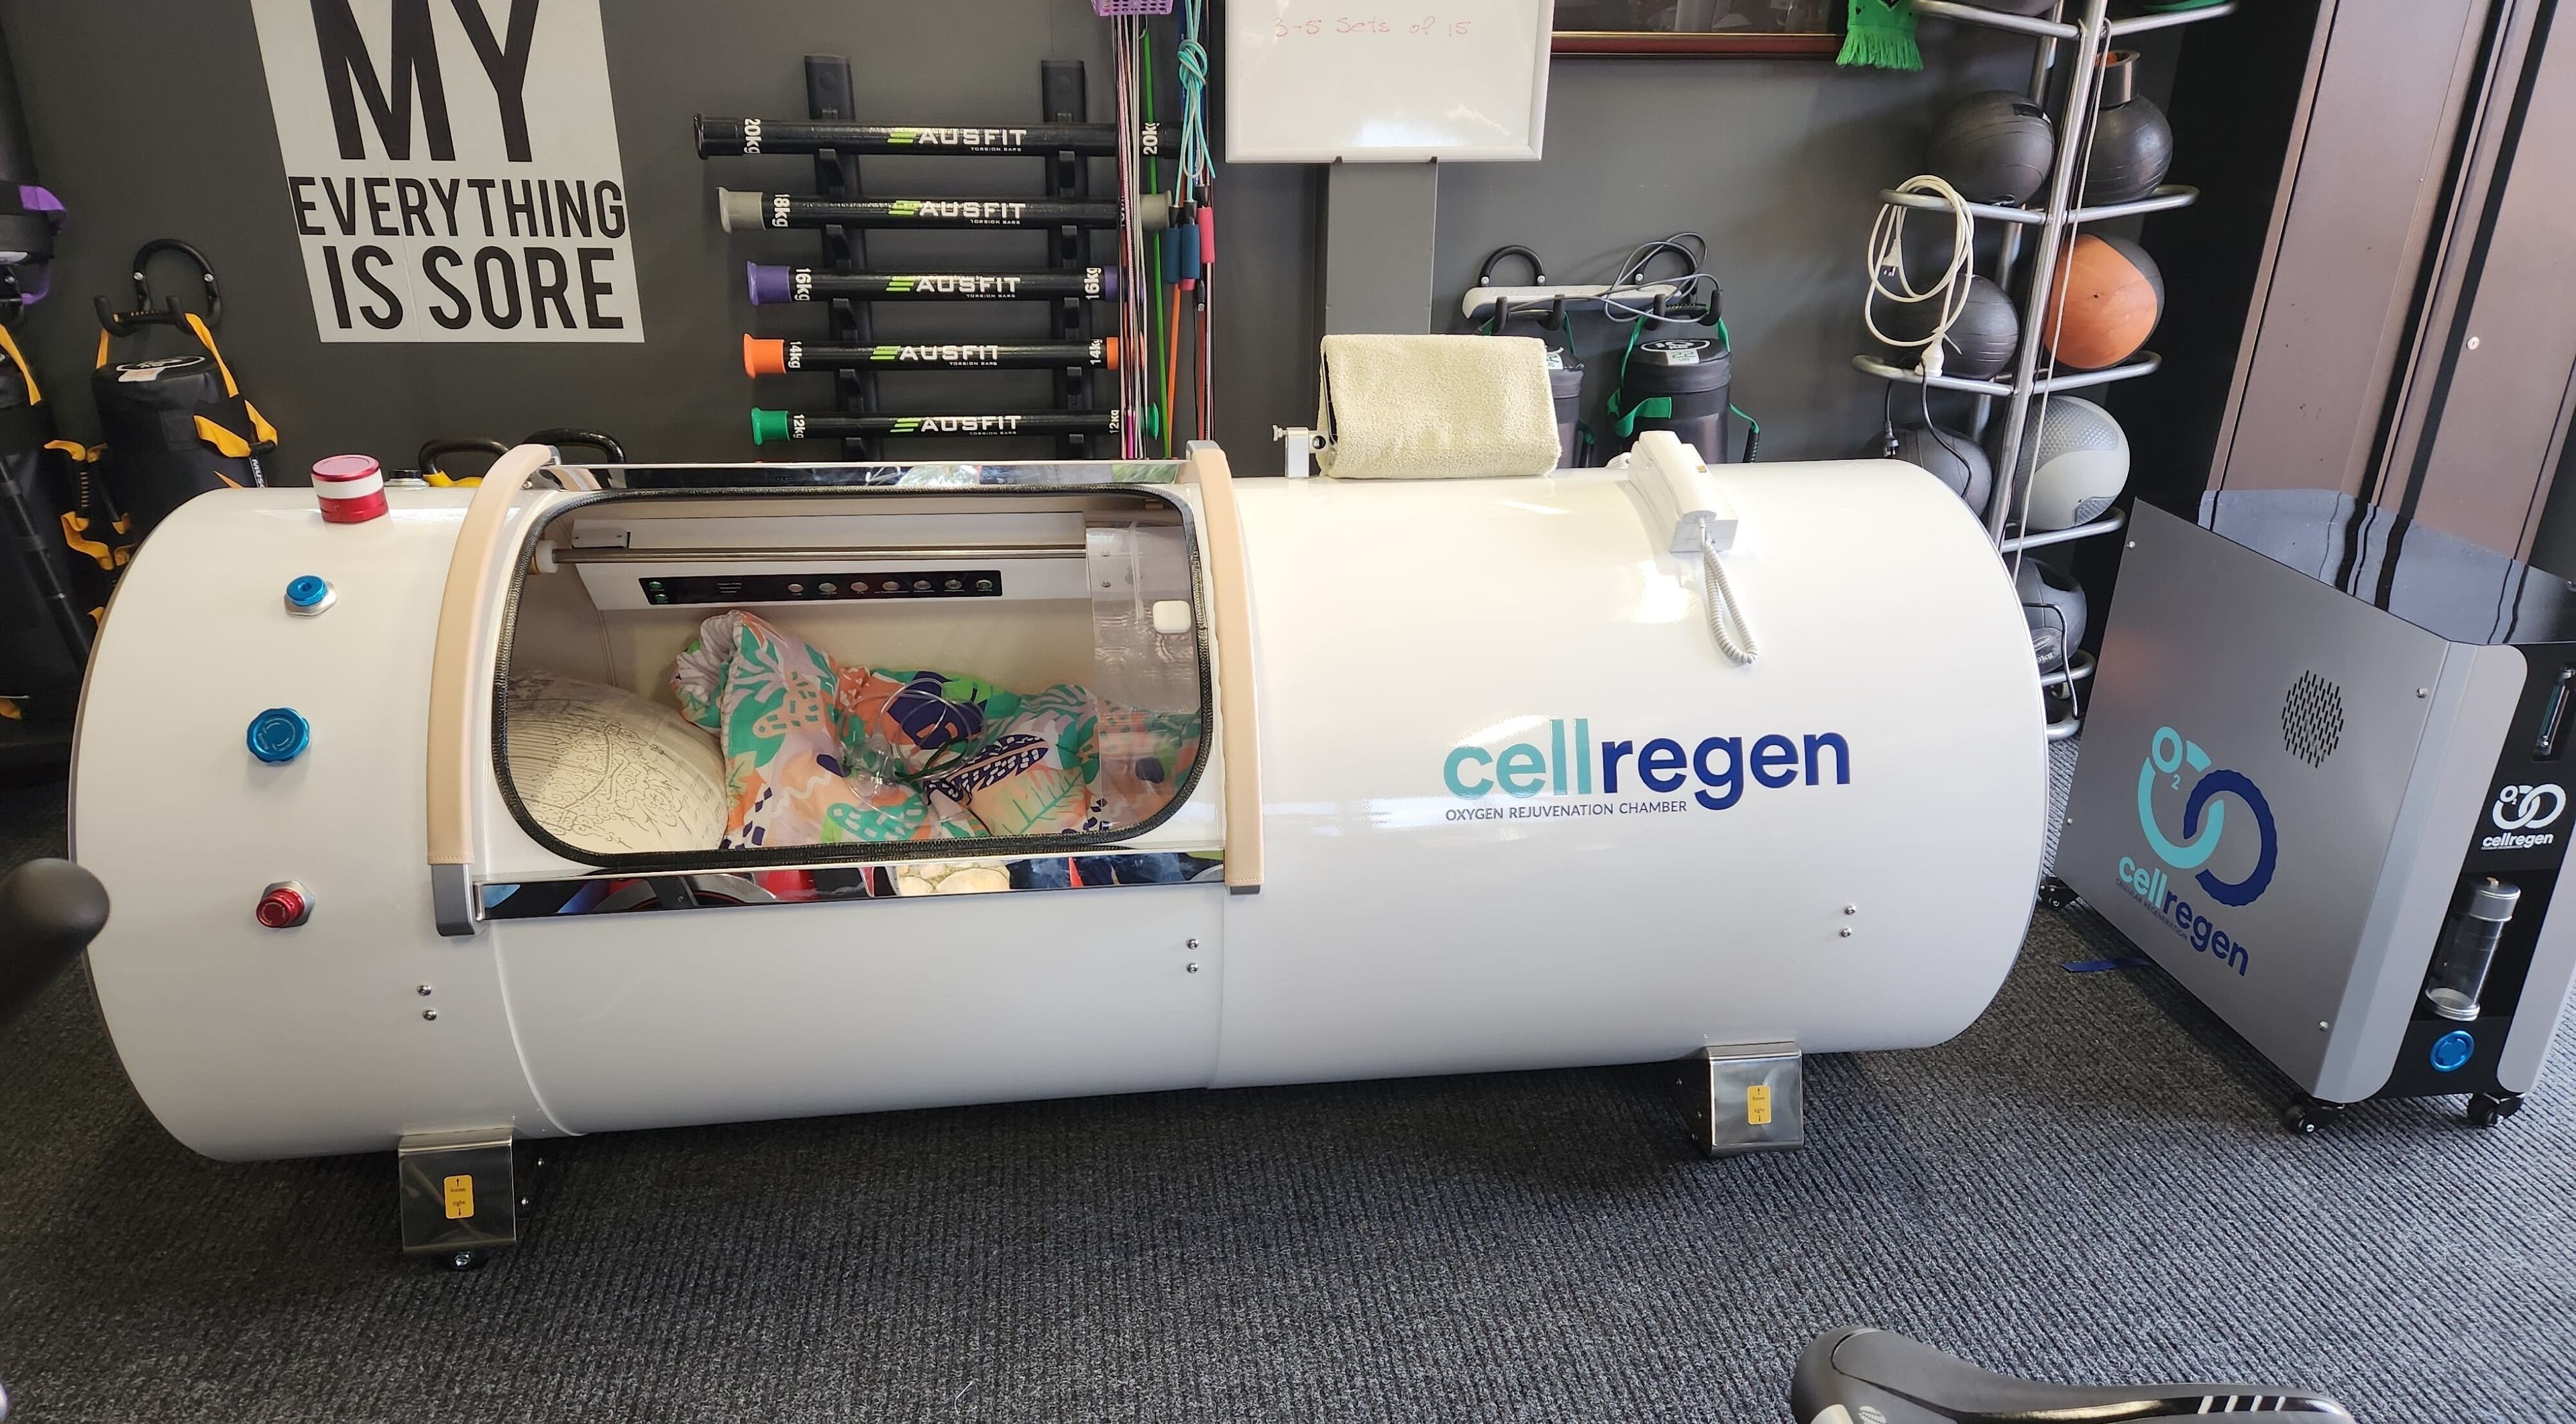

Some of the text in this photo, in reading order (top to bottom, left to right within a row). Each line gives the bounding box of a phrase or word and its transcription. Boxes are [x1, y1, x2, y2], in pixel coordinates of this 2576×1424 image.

[1409, 16, 1436, 35] of
[1448, 21, 1471, 37] 15
[310, 0, 539, 162] MY
[744, 117, 761, 154] 20kg
[918, 129, 1027, 146] AUSFIT
[288, 176, 626, 239] EVERYTHING
[771, 193, 791, 227] 18kg
[919, 201, 1026, 219] AUSFIT
[323, 245, 624, 330] IS SORE
[795, 268, 812, 301] 16kg
[916, 276, 1021, 292] AUSFIT
[1085, 267, 1102, 300] 16kg
[788, 341, 802, 369] 14kg
[899, 345, 998, 360] AUSFIT
[793, 414, 805, 439] 12kg
[920, 415, 1022, 432] AUSFIT
[1444, 718, 1851, 810] cellregen
[1446, 800, 1687, 821] OXYGEN REJUVENATION CHAMBER
[2483, 832, 2554, 848] cellregen
[2118, 856, 2249, 977] cellregen
